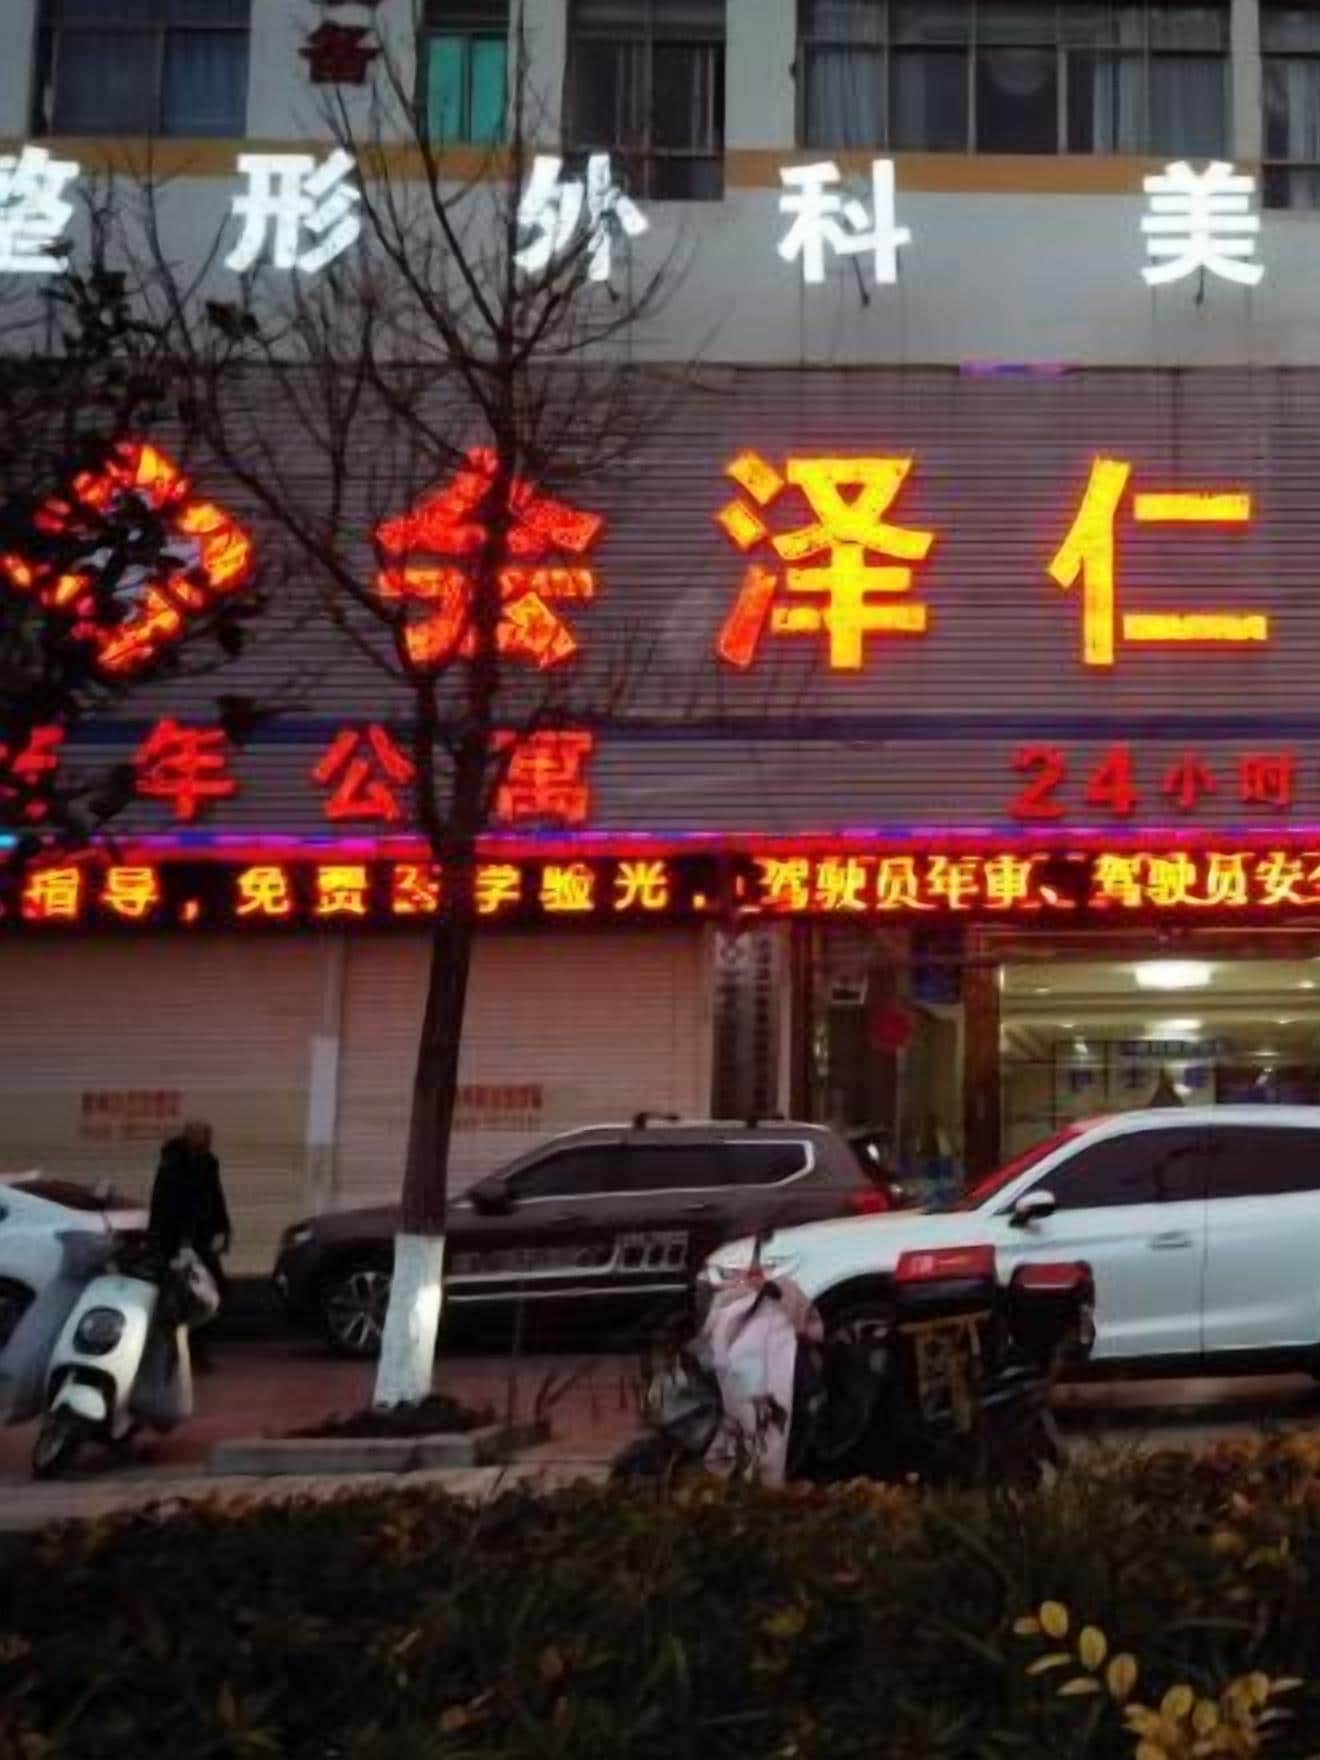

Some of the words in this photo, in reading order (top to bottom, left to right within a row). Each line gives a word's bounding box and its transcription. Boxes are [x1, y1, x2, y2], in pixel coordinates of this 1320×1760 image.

[0, 144, 913, 284] 整形外科
[0, 717, 594, 822] 年公寓
